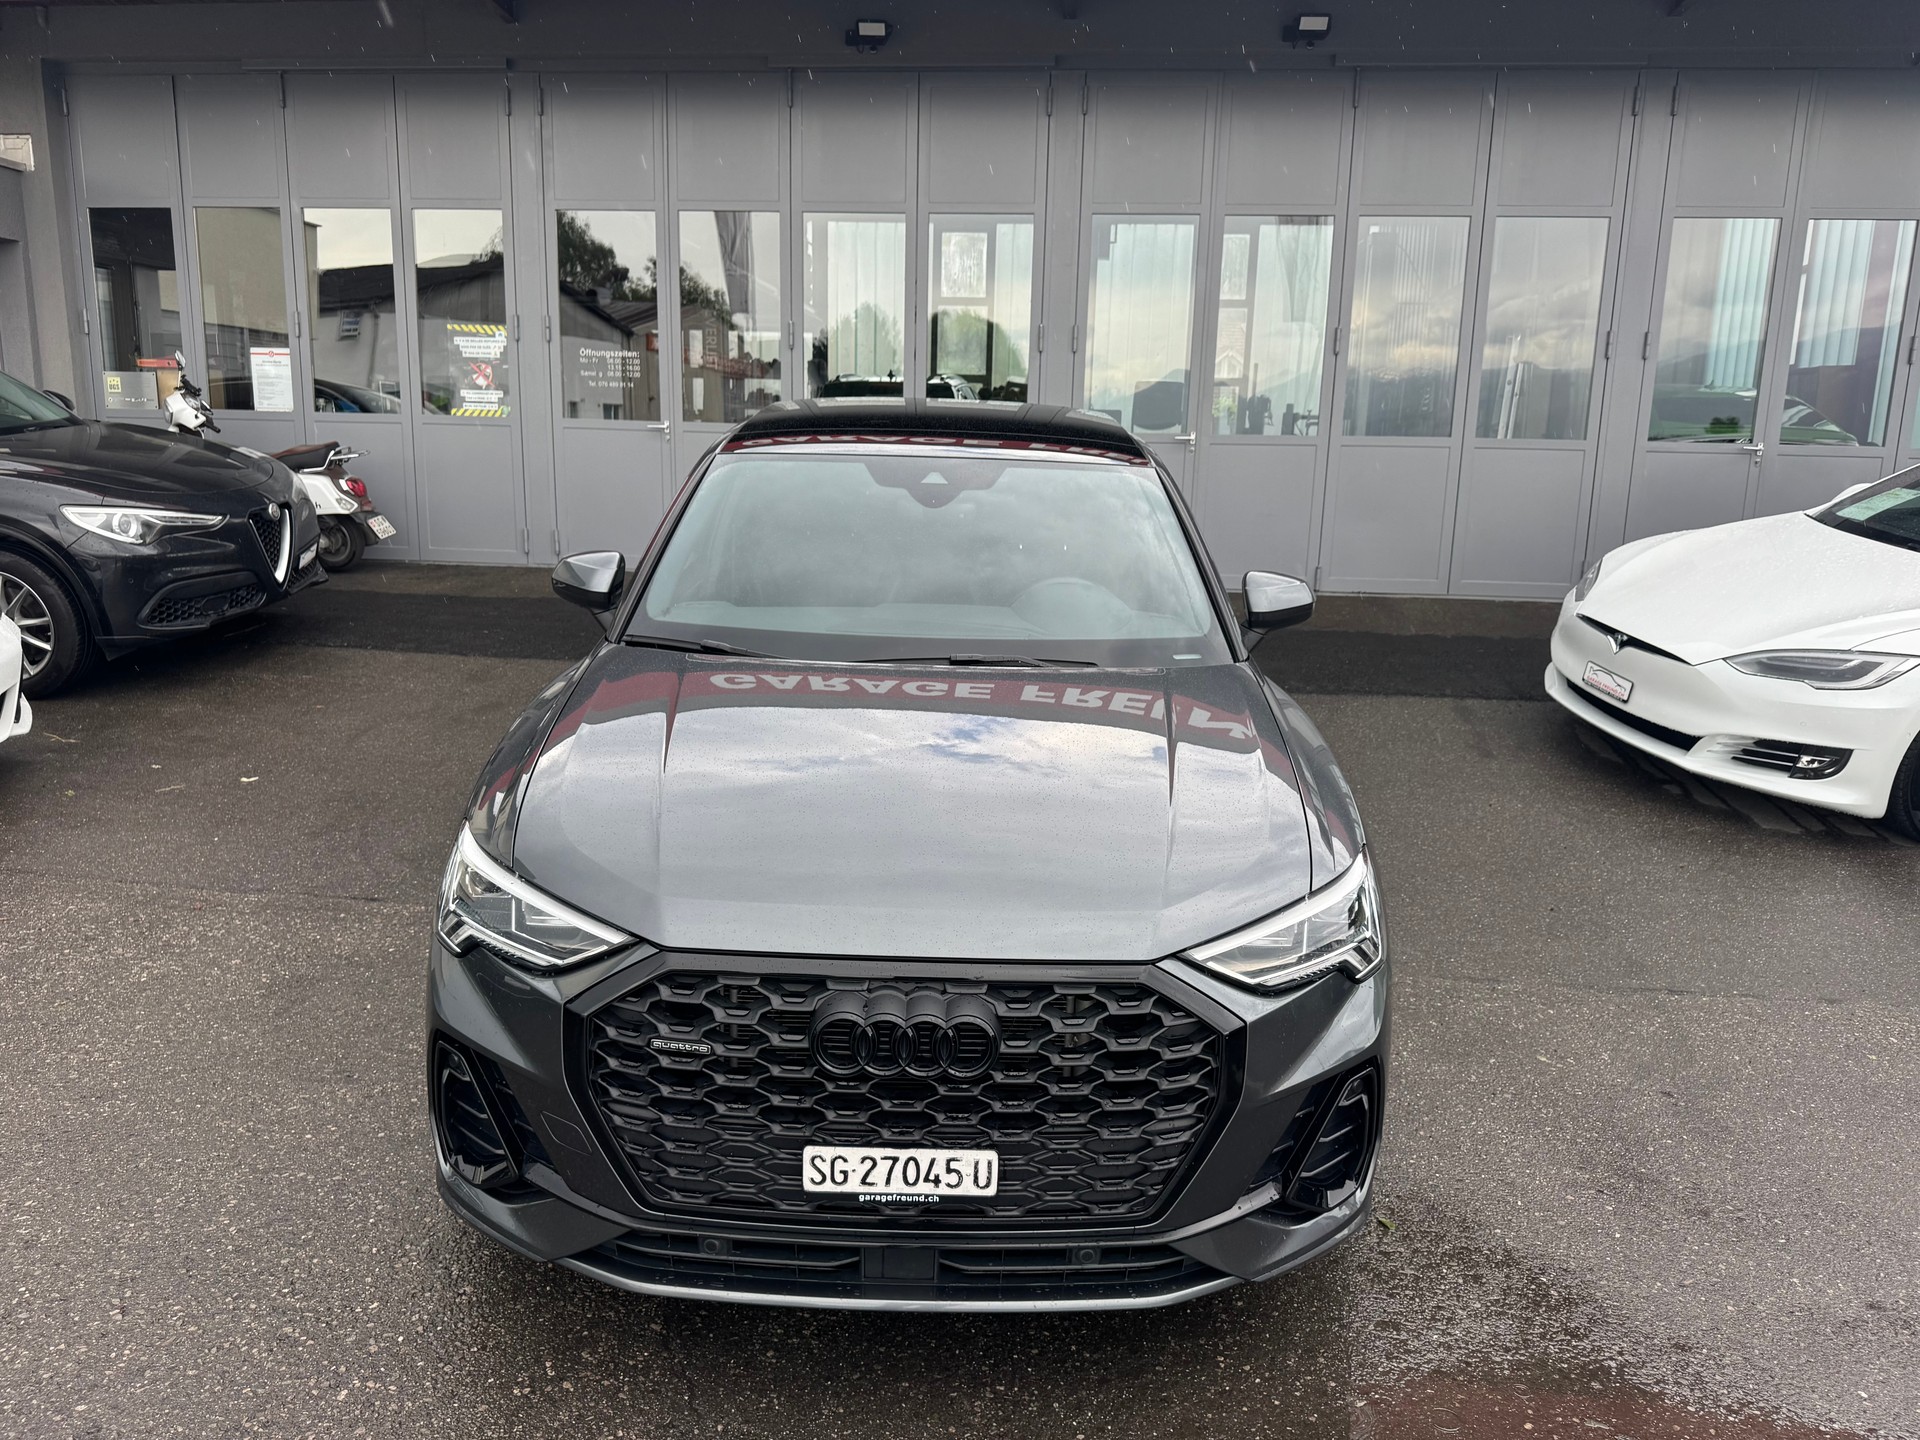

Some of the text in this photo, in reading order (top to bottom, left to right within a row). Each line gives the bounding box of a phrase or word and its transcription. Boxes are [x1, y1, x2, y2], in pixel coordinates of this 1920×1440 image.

[579, 347, 640, 358] Öffnungszeiten:
[653, 1041, 708, 1053] quattro
[858, 1193, 941, 1203] garagefreund.ch
